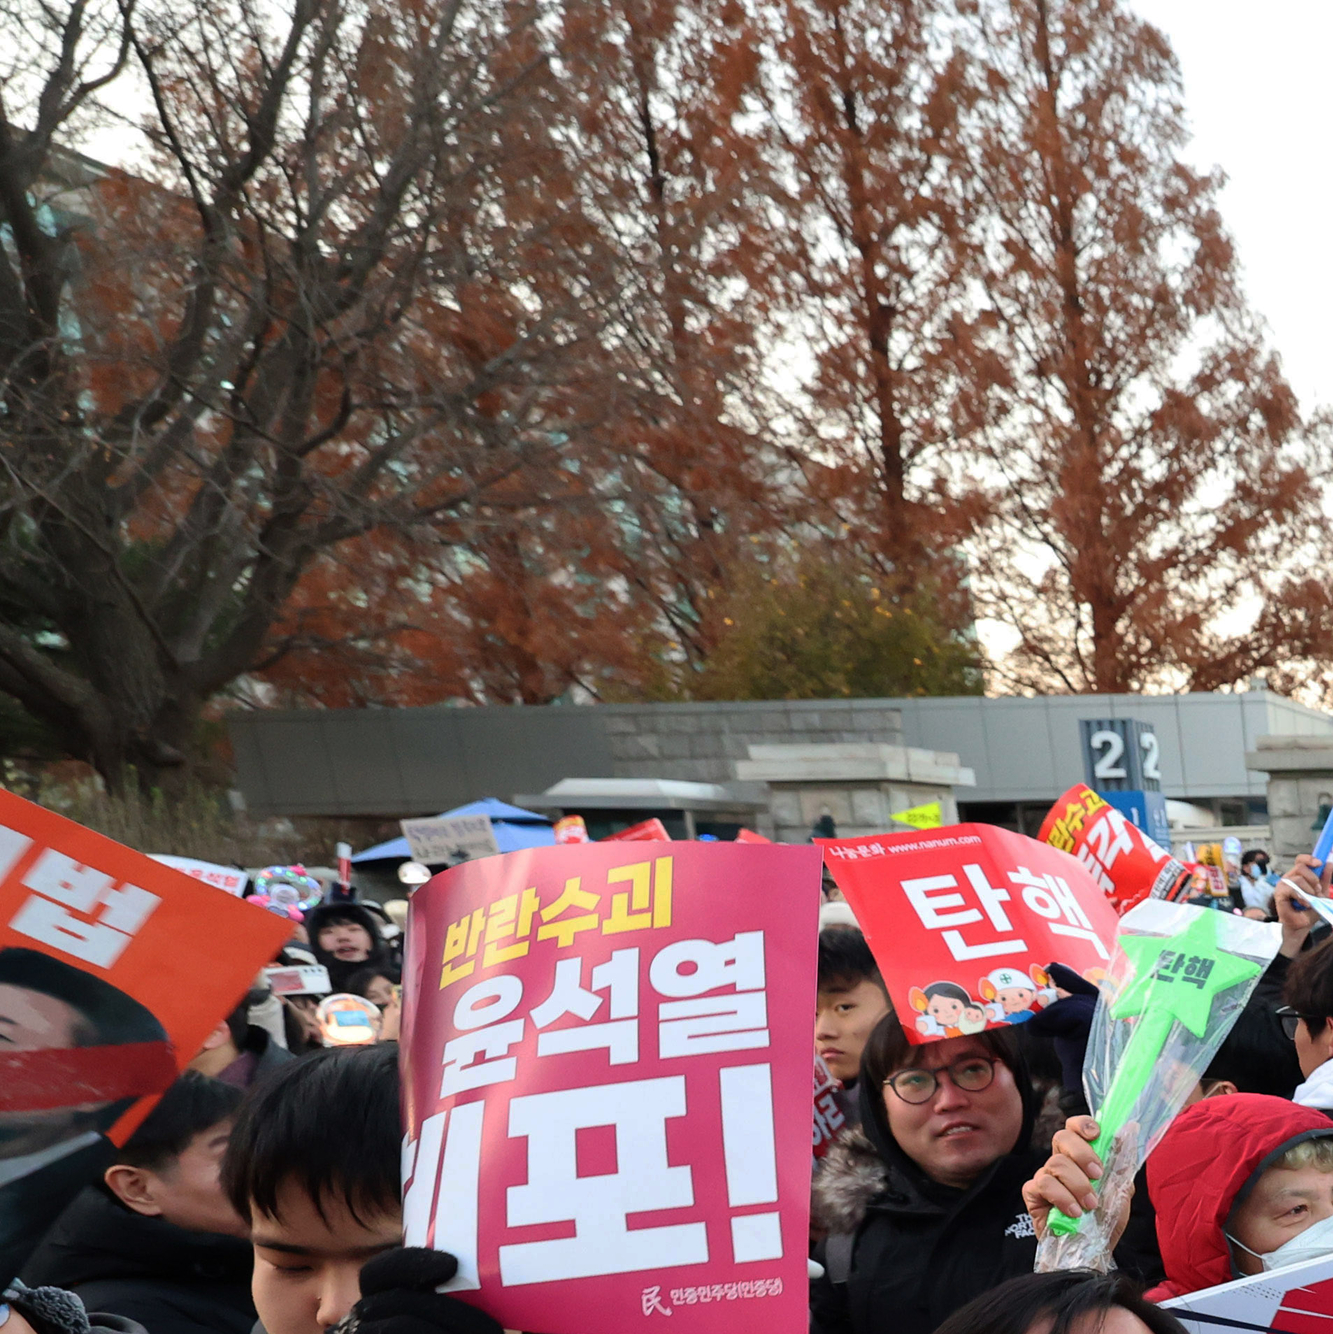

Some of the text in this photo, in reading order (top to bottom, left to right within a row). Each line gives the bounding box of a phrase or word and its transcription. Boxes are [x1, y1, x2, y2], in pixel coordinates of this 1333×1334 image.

[1091, 730, 1127, 779] 2
[1139, 732, 1161, 778] 2
[829, 834, 982, 860] 나눔문화 www.nanum.com
[440, 857, 672, 990] 반란수괴
[900, 863, 1110, 962] 탄핵
[1155, 949, 1215, 989] 탄핵
[440, 931, 770, 1099] 윤석열
